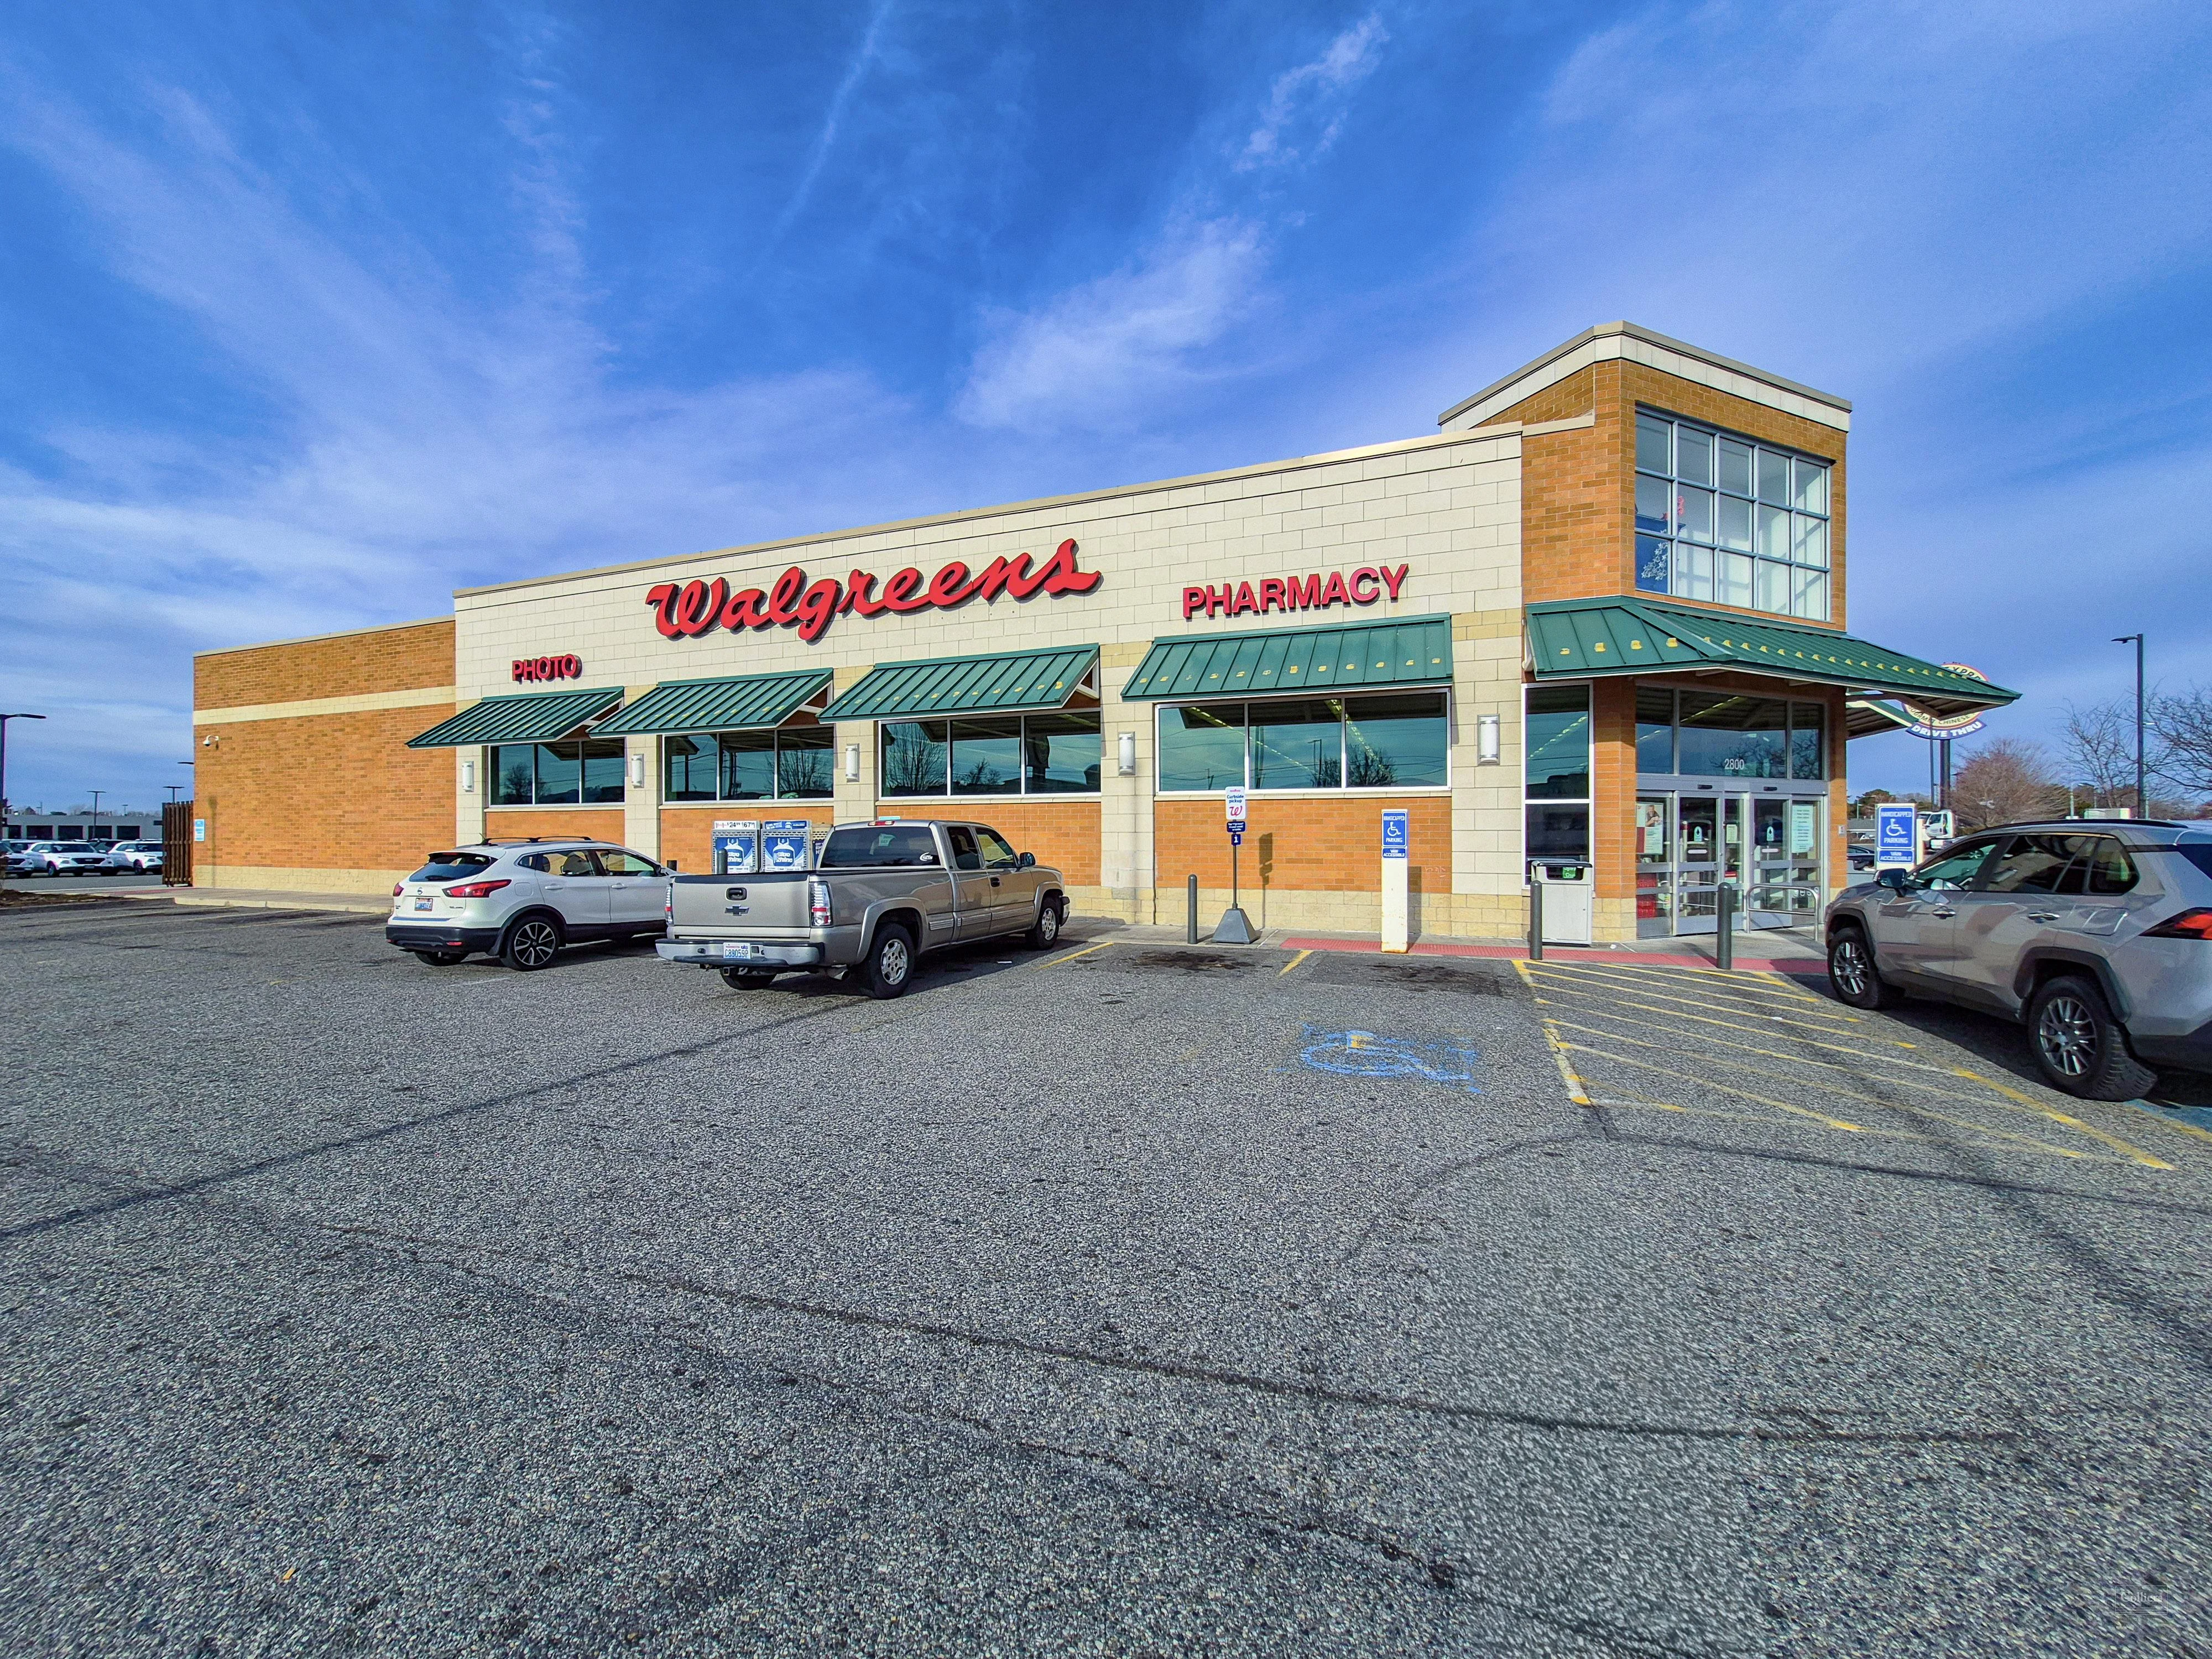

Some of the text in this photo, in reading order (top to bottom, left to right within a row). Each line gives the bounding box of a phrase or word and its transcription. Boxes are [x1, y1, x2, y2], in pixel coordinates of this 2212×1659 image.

[646, 538, 1101, 641] Walgreens
[1182, 564, 1409, 619] PHARMACY
[512, 654, 580, 682] PHOTO
[1911, 721, 1983, 737] DRIVE THRU
[1725, 758, 1745, 770] 2800
